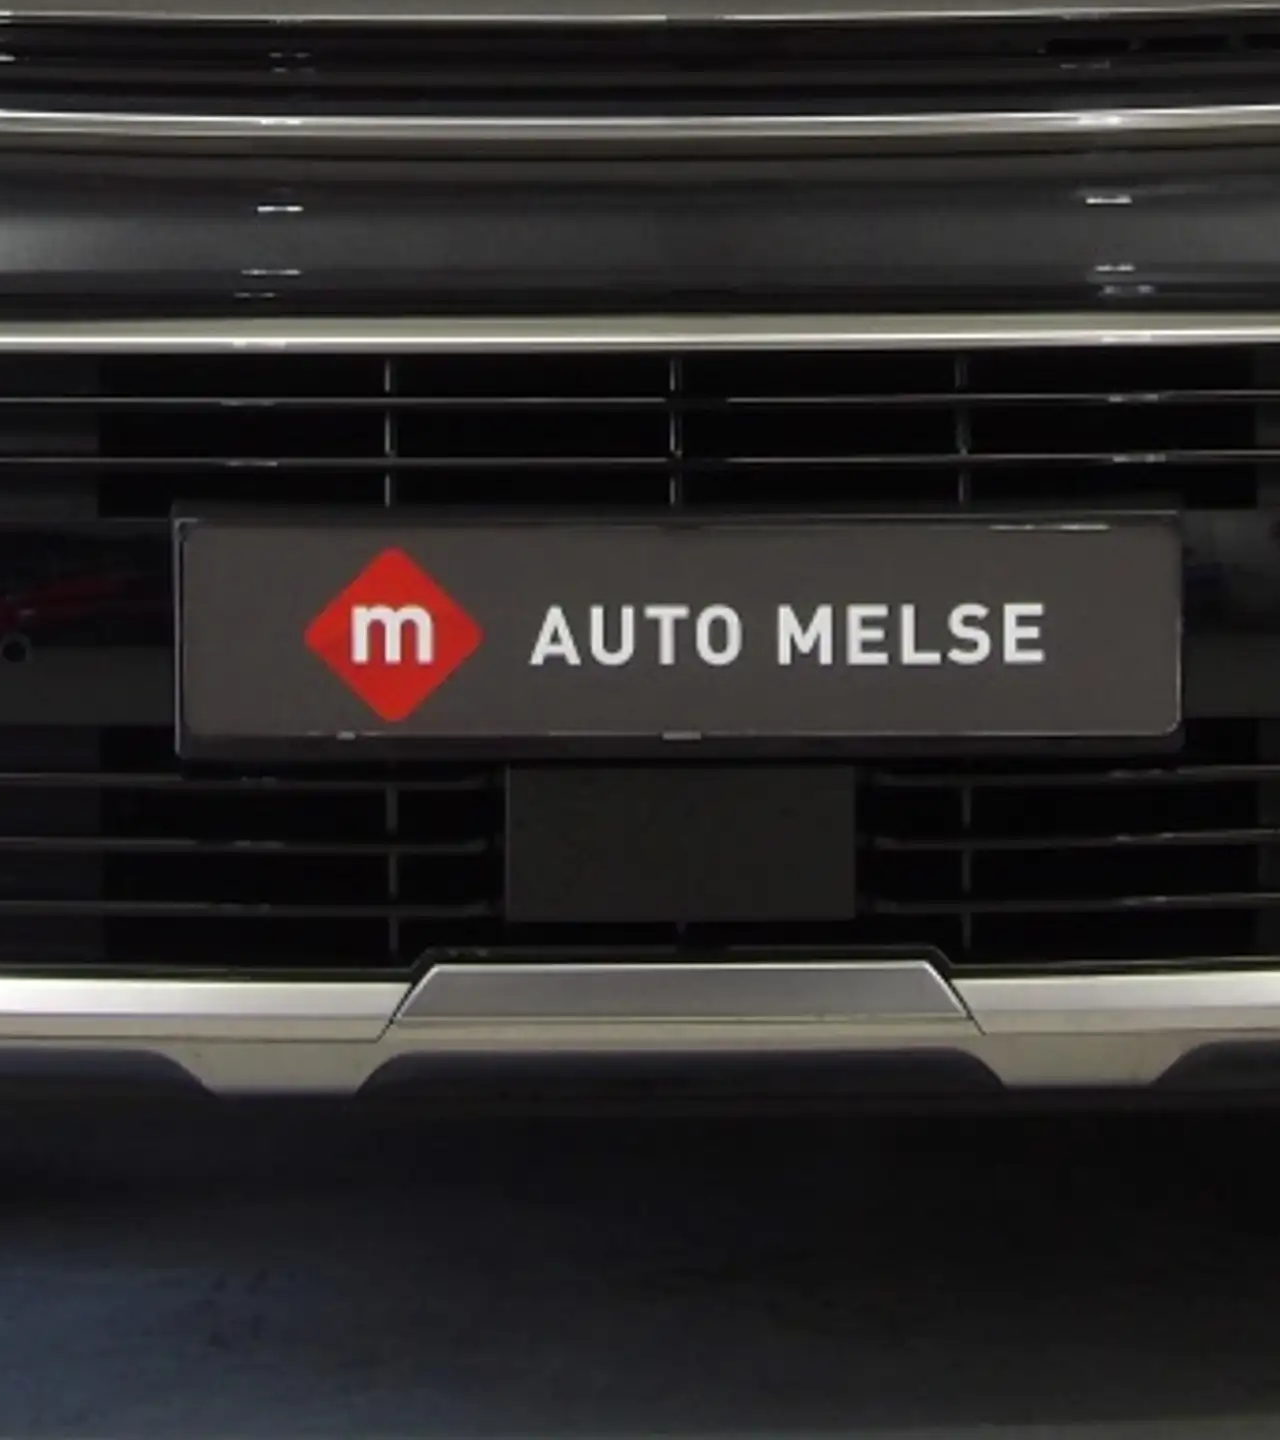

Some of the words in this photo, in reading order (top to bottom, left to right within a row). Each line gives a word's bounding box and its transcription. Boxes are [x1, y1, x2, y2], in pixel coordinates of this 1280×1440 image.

[351, 603, 434, 664] m
[529, 604, 743, 667] AUTO
[776, 602, 1046, 666] MELSE
